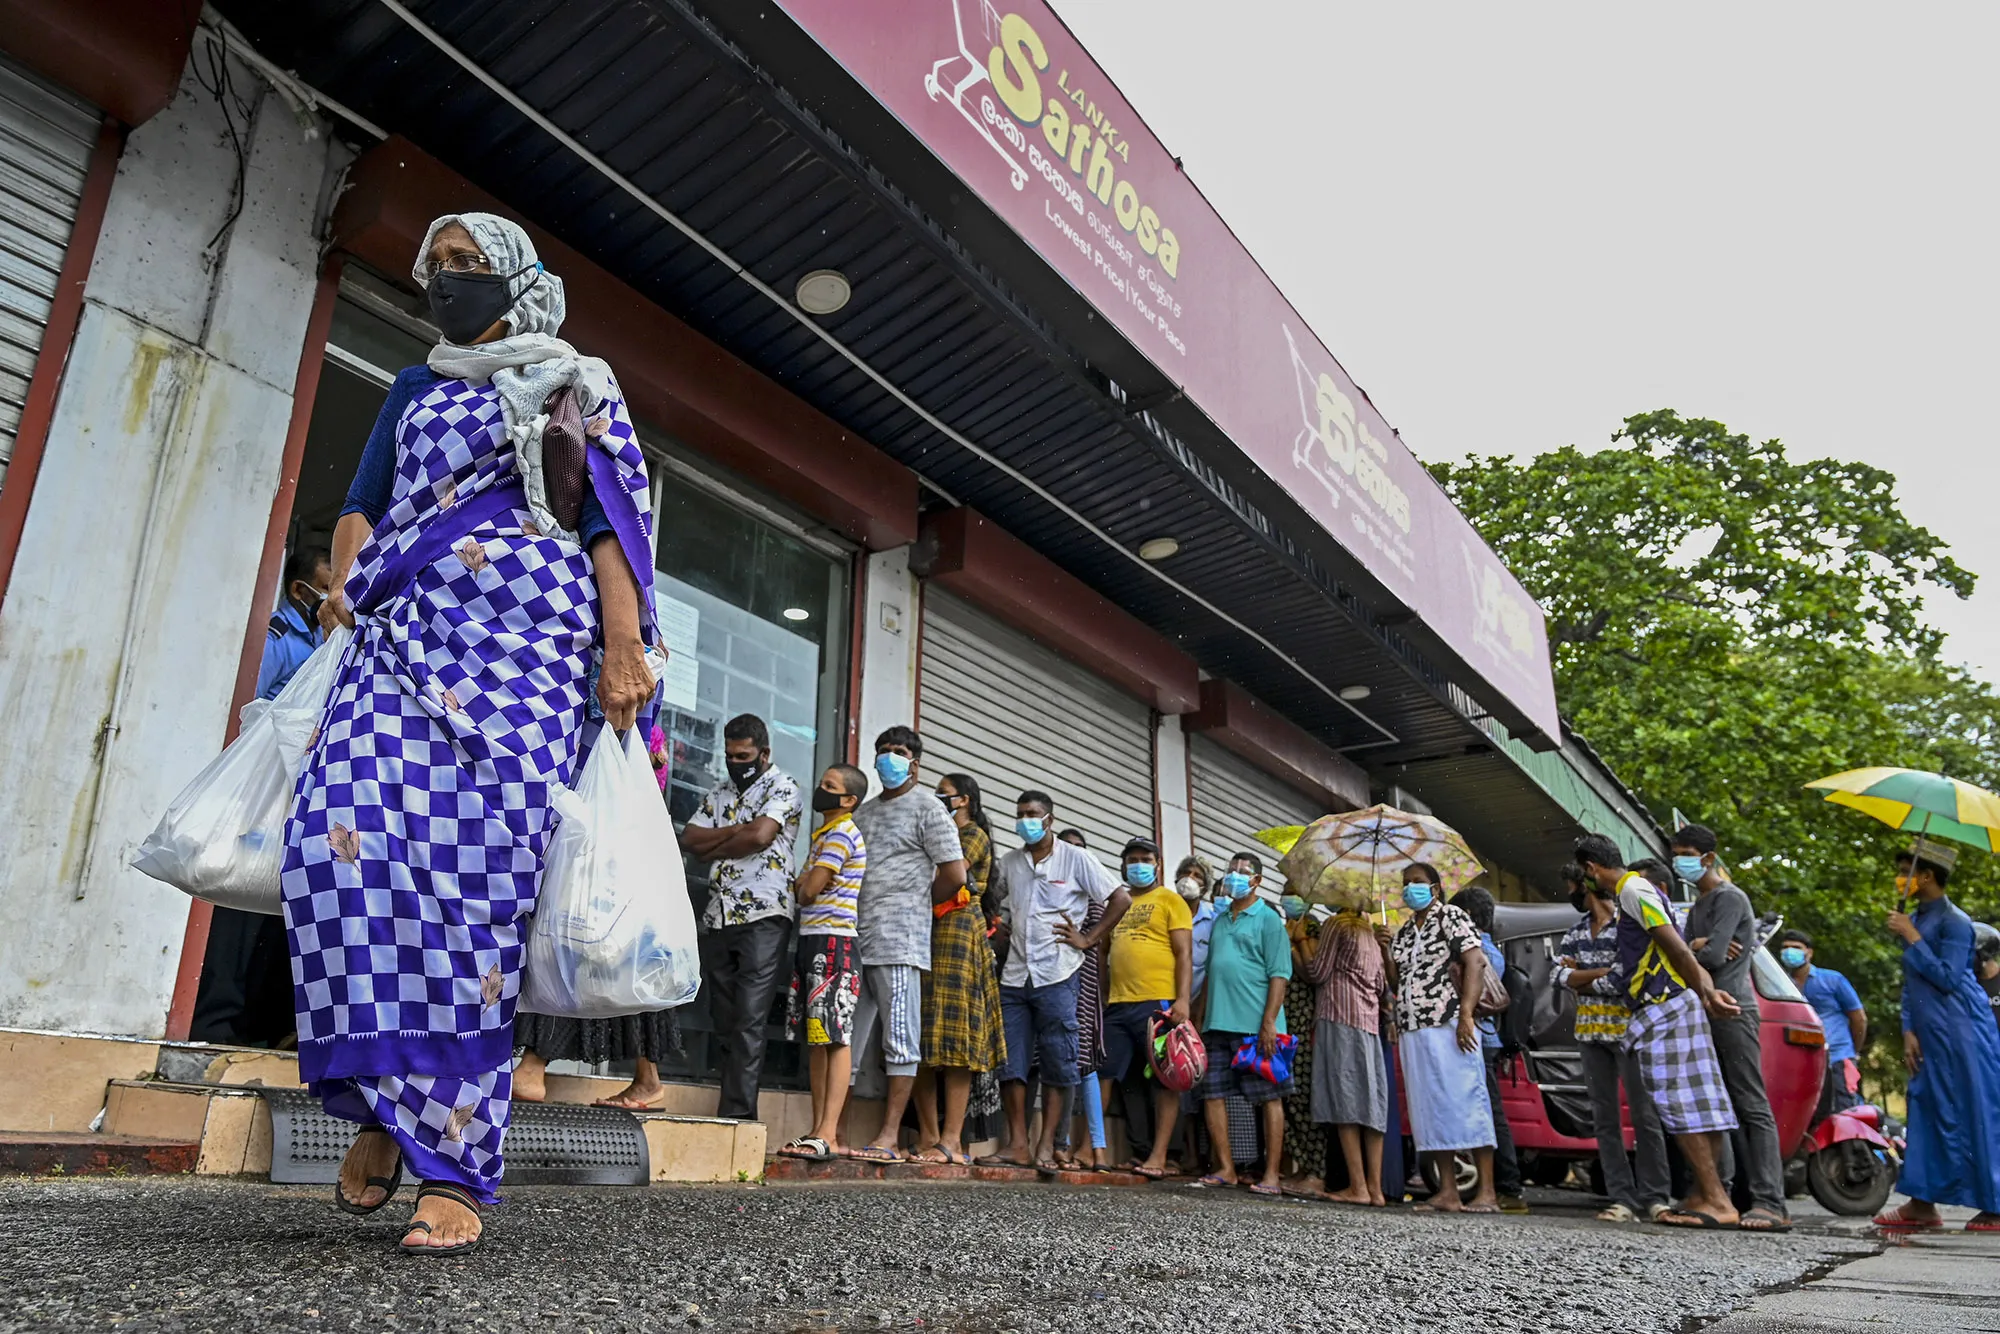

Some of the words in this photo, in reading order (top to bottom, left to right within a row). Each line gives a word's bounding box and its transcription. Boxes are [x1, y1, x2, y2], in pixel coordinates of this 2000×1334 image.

[981, 95, 1026, 153] ලංකා
[988, 13, 1181, 281] Sathosa
[1057, 69, 1130, 164] LANKA
[1045, 199, 1092, 261] Lowest
[1158, 316, 1187, 357] Place
